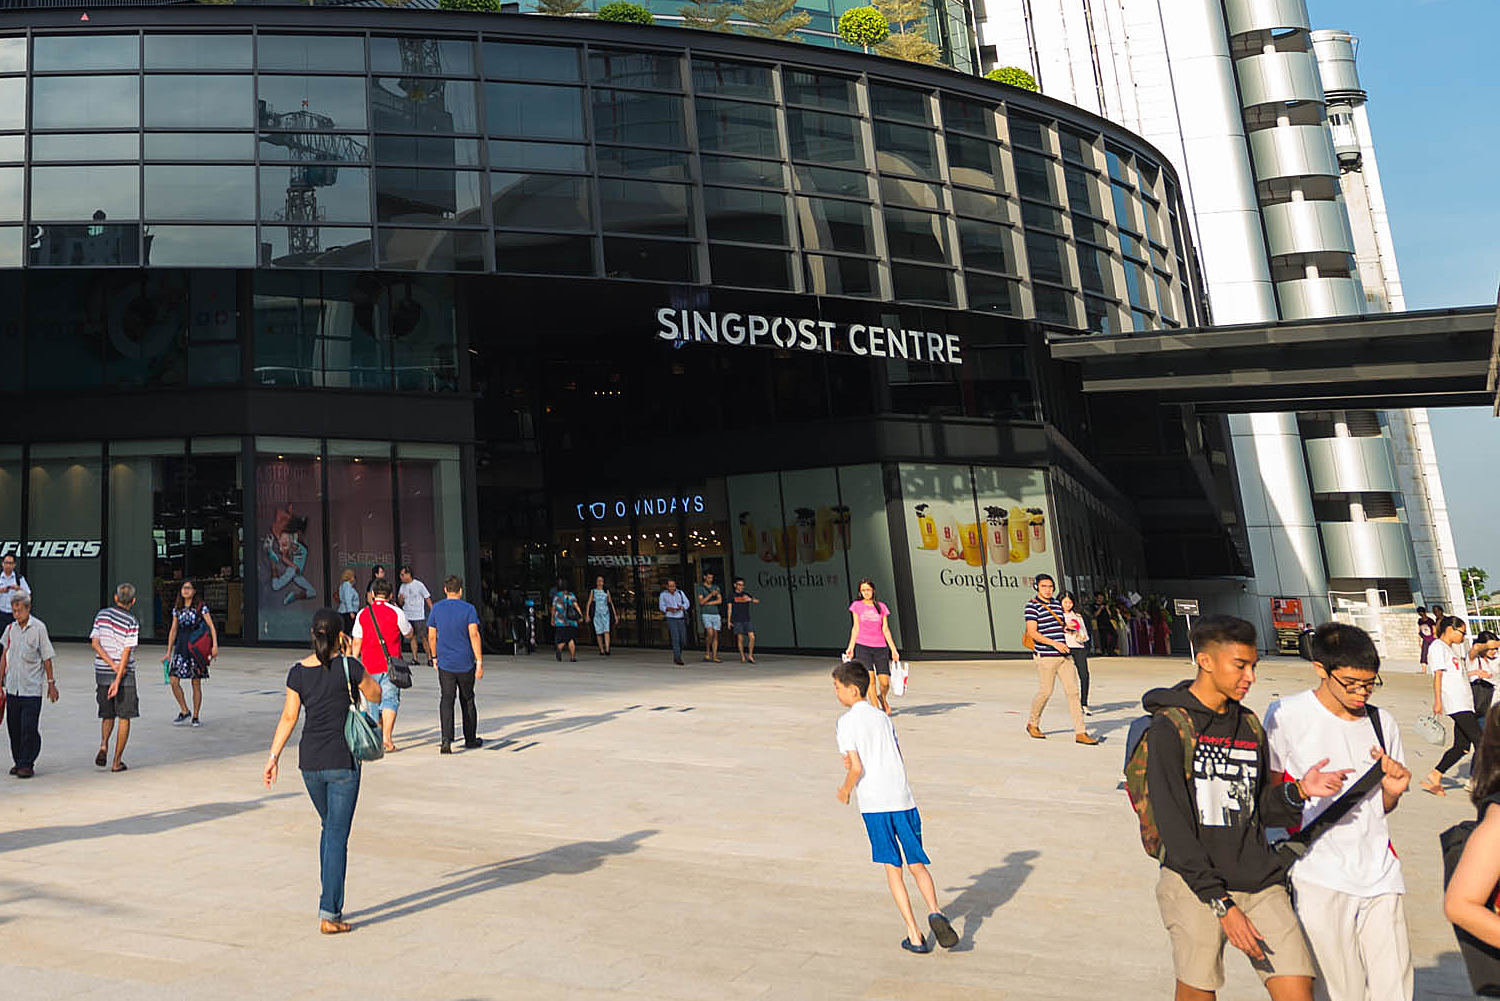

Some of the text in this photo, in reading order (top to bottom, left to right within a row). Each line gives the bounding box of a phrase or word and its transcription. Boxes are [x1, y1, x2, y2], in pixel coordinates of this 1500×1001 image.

[656, 307, 963, 364] SINGPOST CENTRE
[799, 568, 824, 587] cha
[940, 568, 987, 592] Gong
[990, 569, 1019, 588] cha
